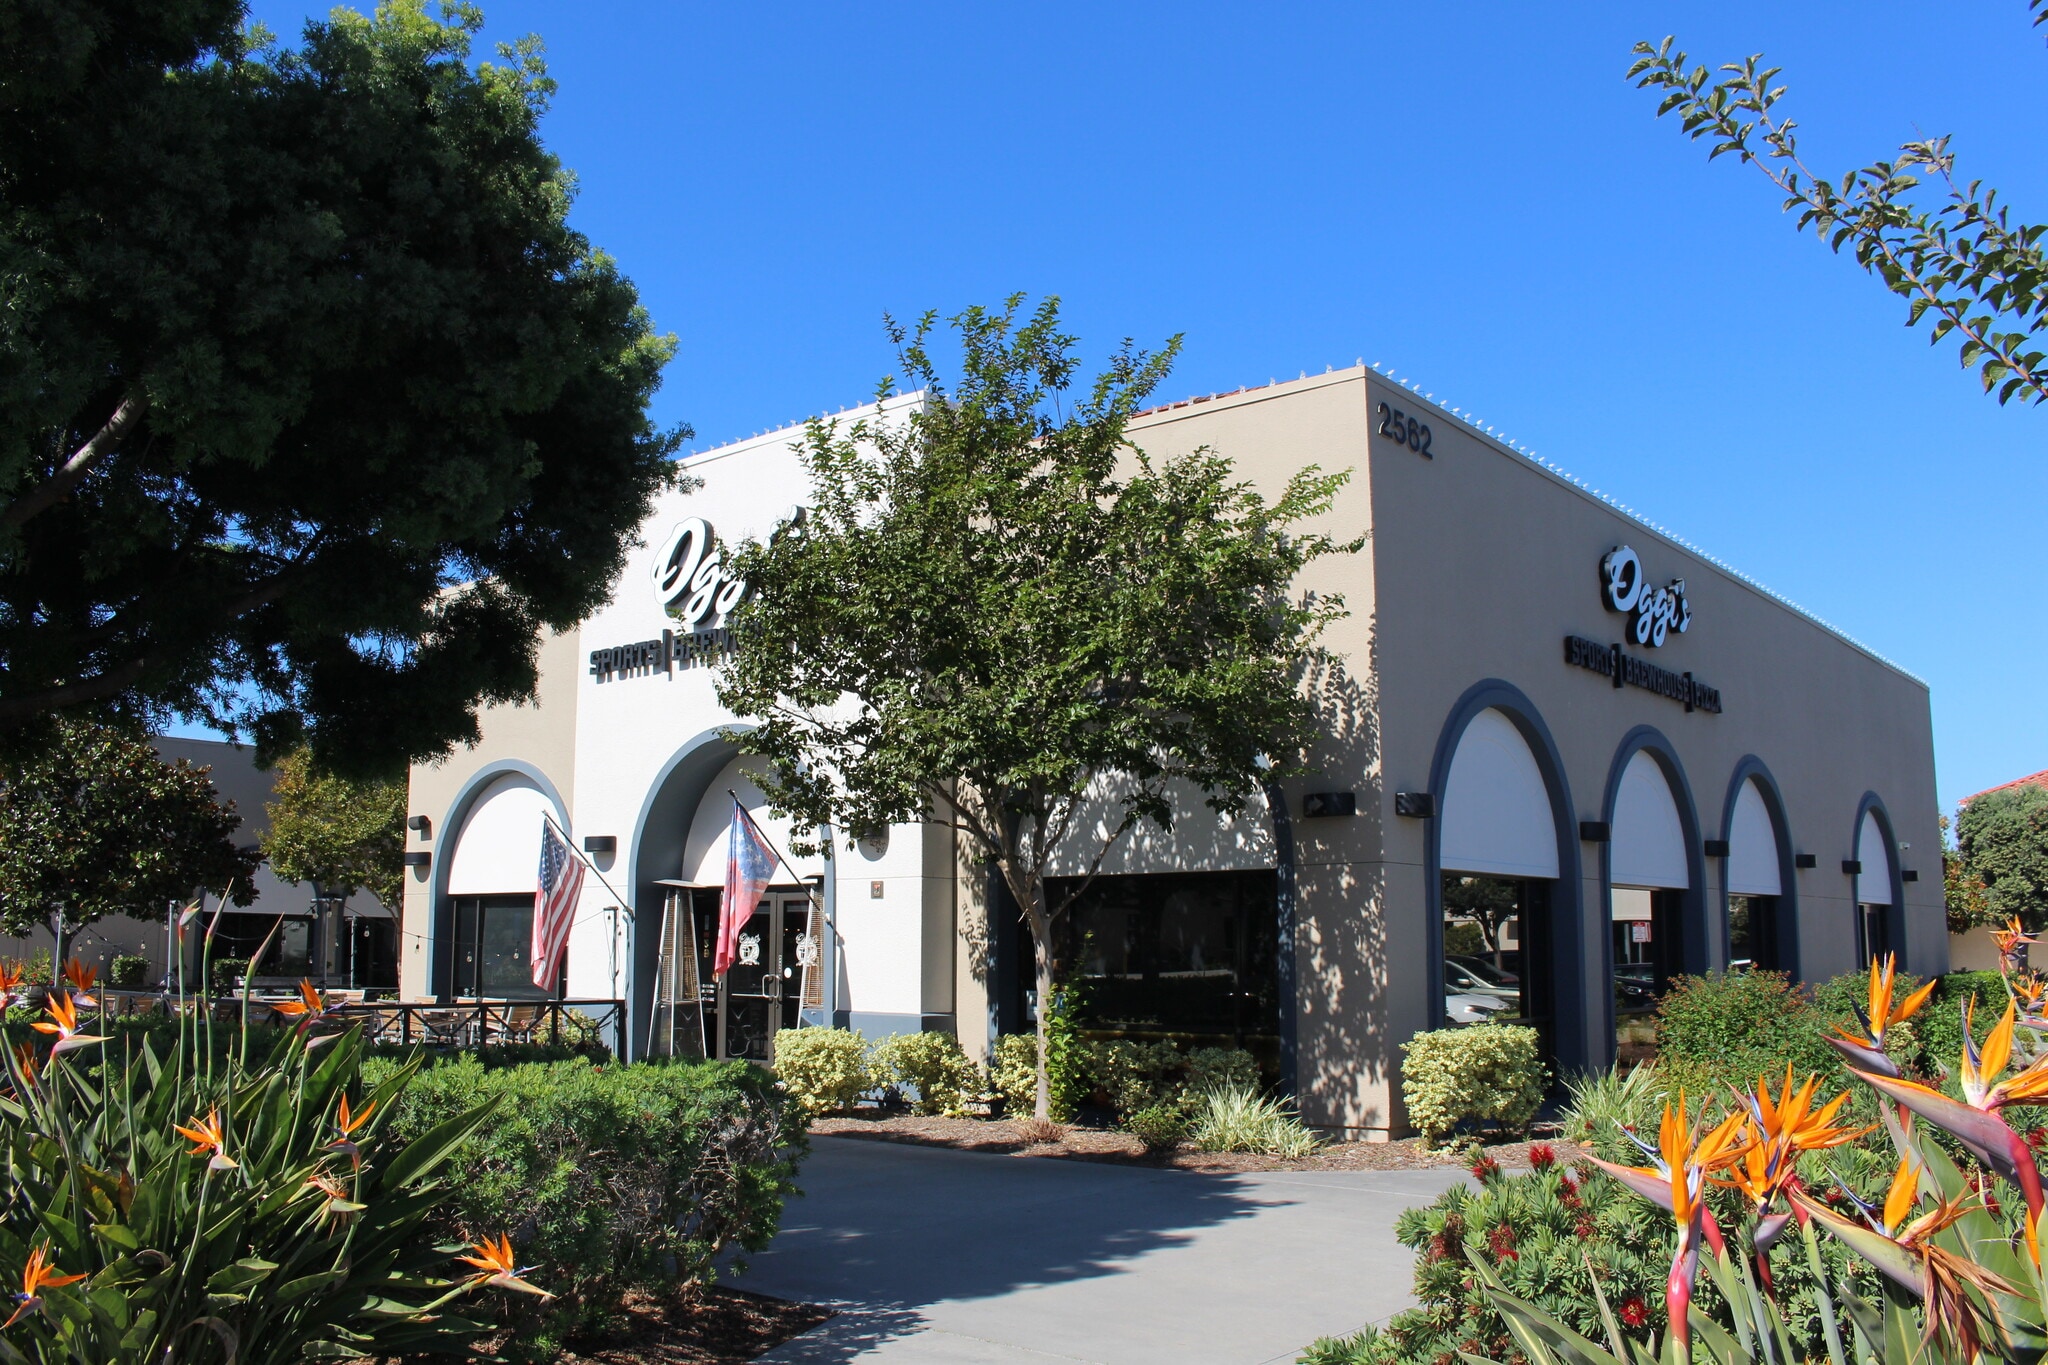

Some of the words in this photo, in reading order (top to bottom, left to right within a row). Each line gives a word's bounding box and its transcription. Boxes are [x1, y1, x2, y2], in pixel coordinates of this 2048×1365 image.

[1377, 401, 1433, 460] 2562
[1602, 545, 1692, 648] Oggi's
[590, 639, 661, 675] SPORTS
[1566, 635, 1617, 677] SPORTS
[1623, 654, 1690, 703] BREWHOUSE
[1694, 681, 1722, 713] PIZZA
